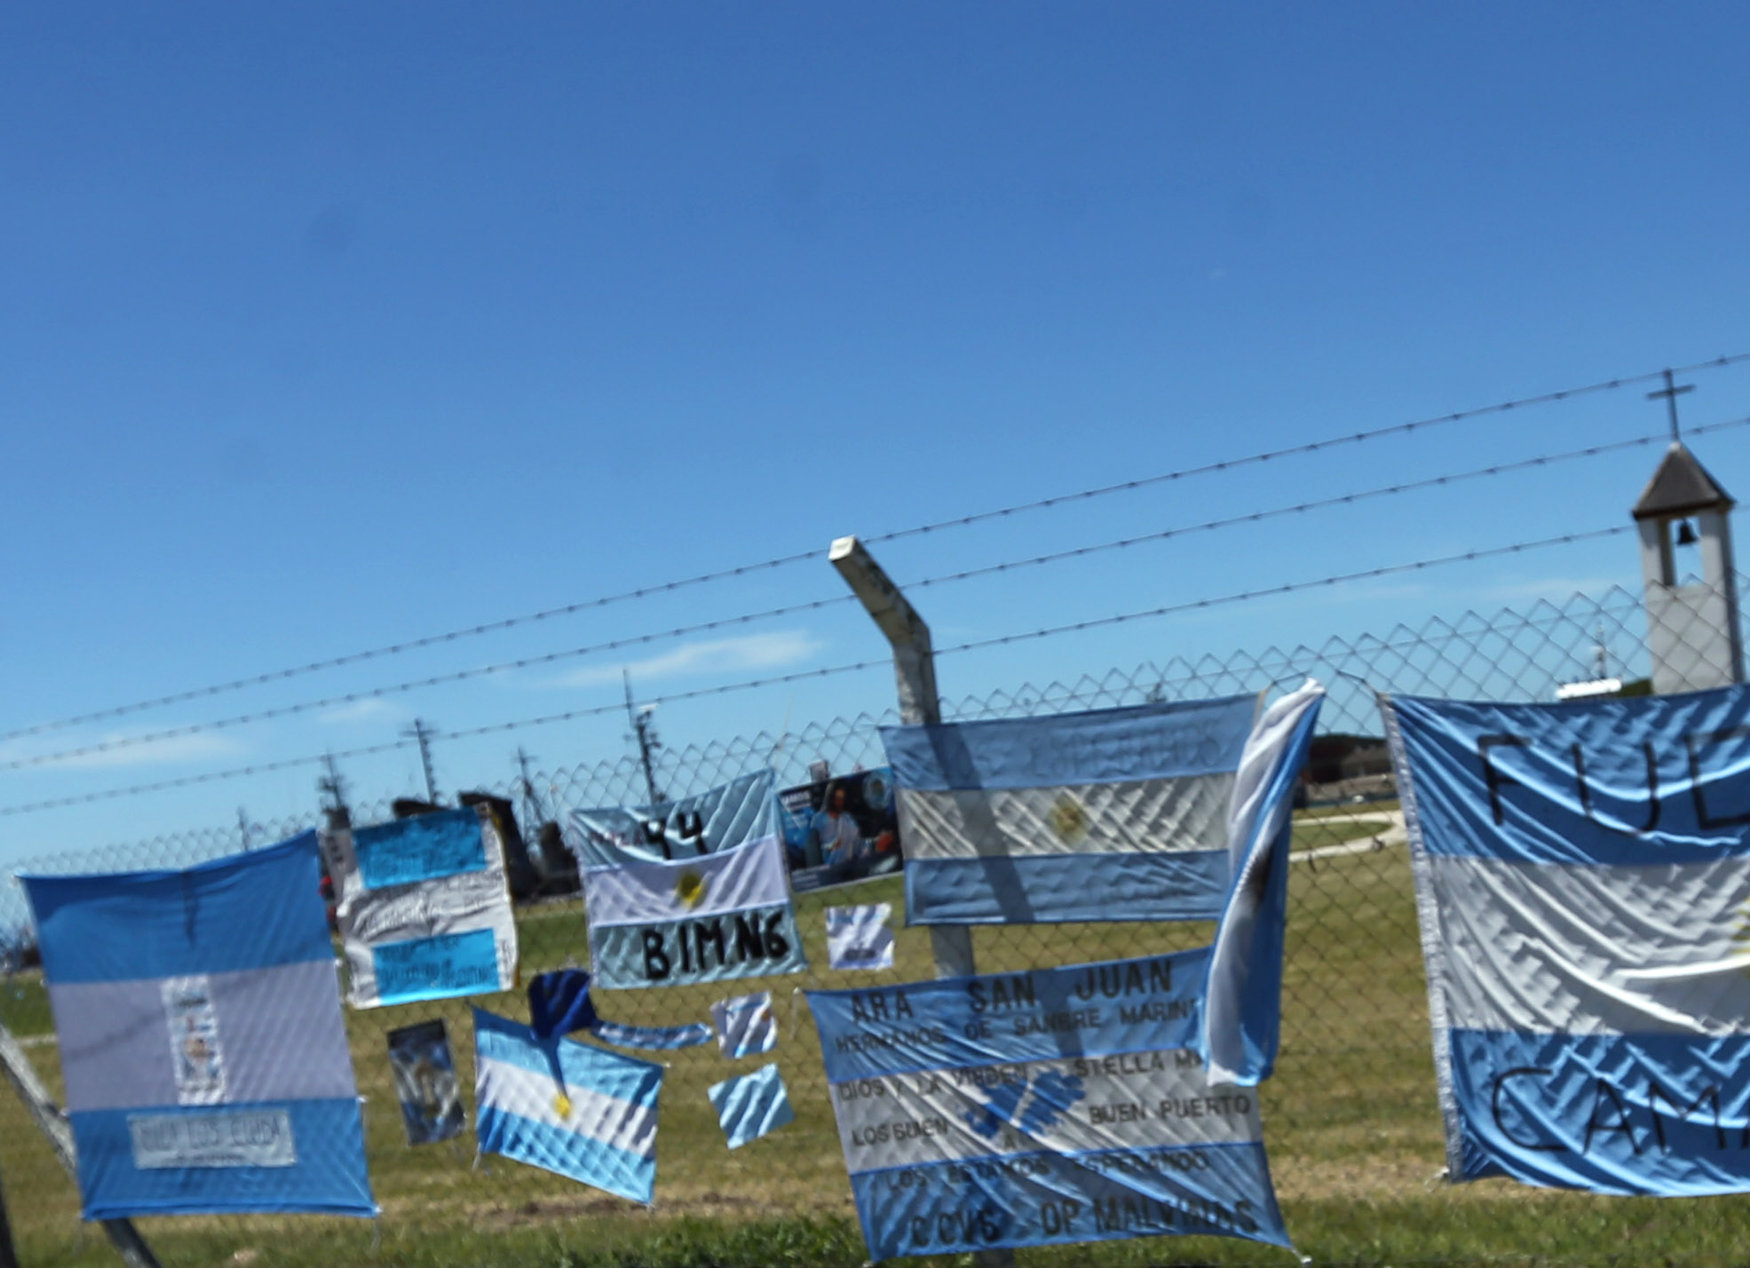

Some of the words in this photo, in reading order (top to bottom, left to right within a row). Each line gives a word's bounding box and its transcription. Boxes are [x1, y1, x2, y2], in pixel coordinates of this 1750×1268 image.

[852, 991, 914, 1023] ARA
[967, 975, 1036, 1014] SAN
[1075, 959, 1172, 1000] JUAN
[1075, 1051, 1165, 1078] STELLA
[852, 1122, 890, 1147] LOS
[1089, 1102, 1148, 1125] BUEN
[1160, 1095, 1252, 1119] PUERTO
[1042, 1200, 1081, 1236] OP
